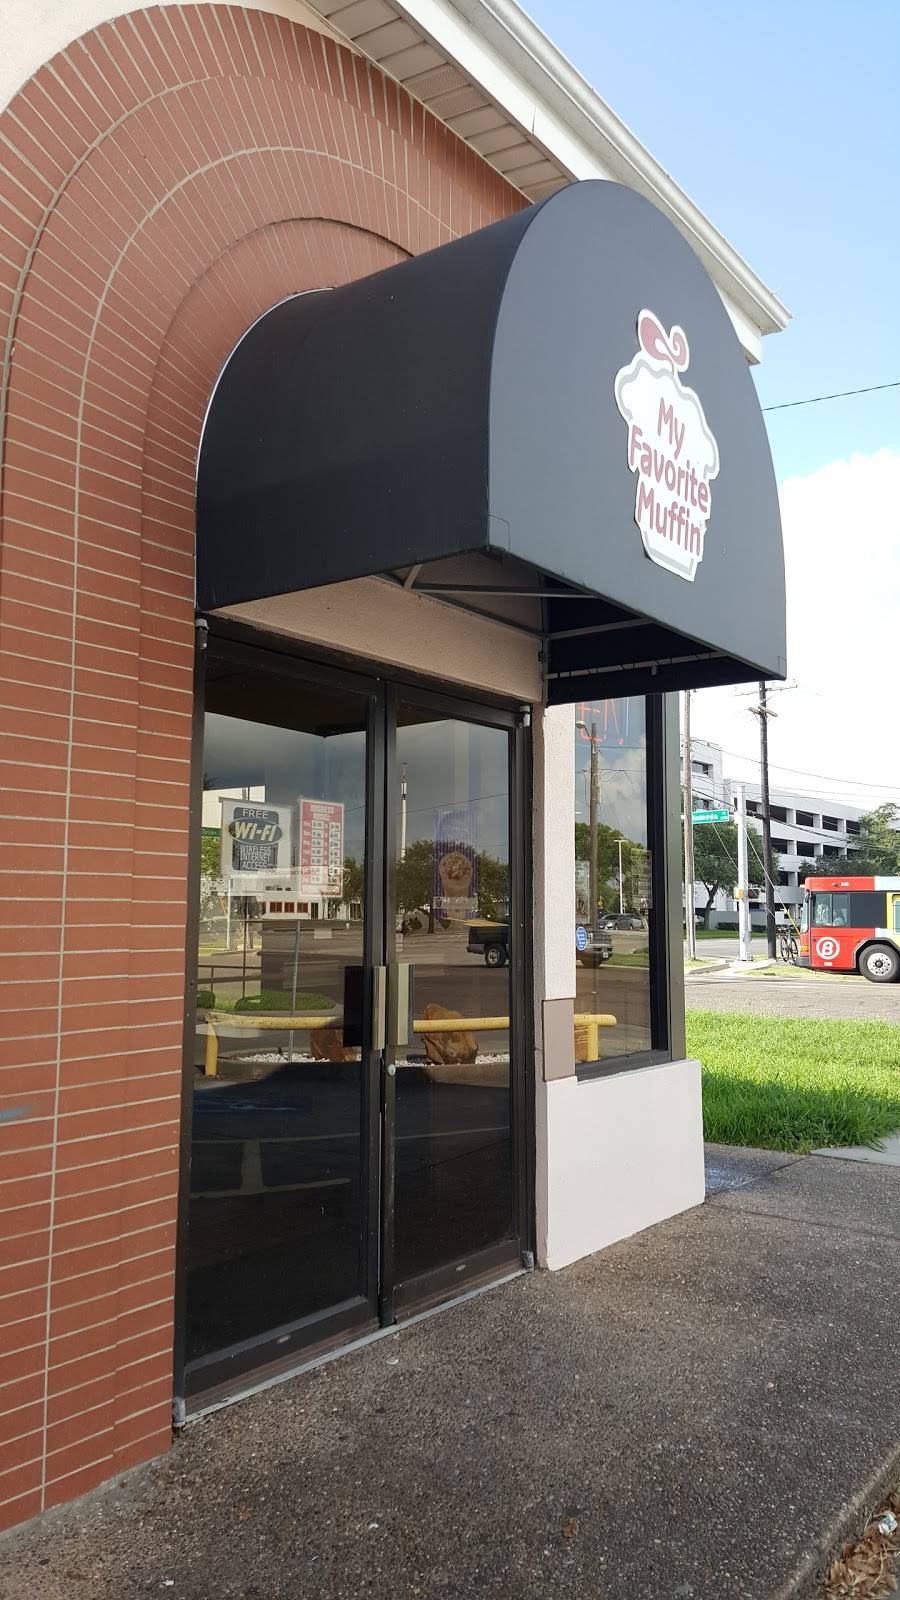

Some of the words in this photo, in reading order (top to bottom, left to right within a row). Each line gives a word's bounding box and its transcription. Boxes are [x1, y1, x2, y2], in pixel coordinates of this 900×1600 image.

[657, 397, 685, 460] My
[630, 424, 709, 513] Favorite
[637, 481, 700, 556] Muffin
[242, 808, 269, 819] FREE
[240, 845, 272, 854] WIRELESS
[240, 852, 271, 862] INTERNET
[241, 861, 267, 870] ACCESS
